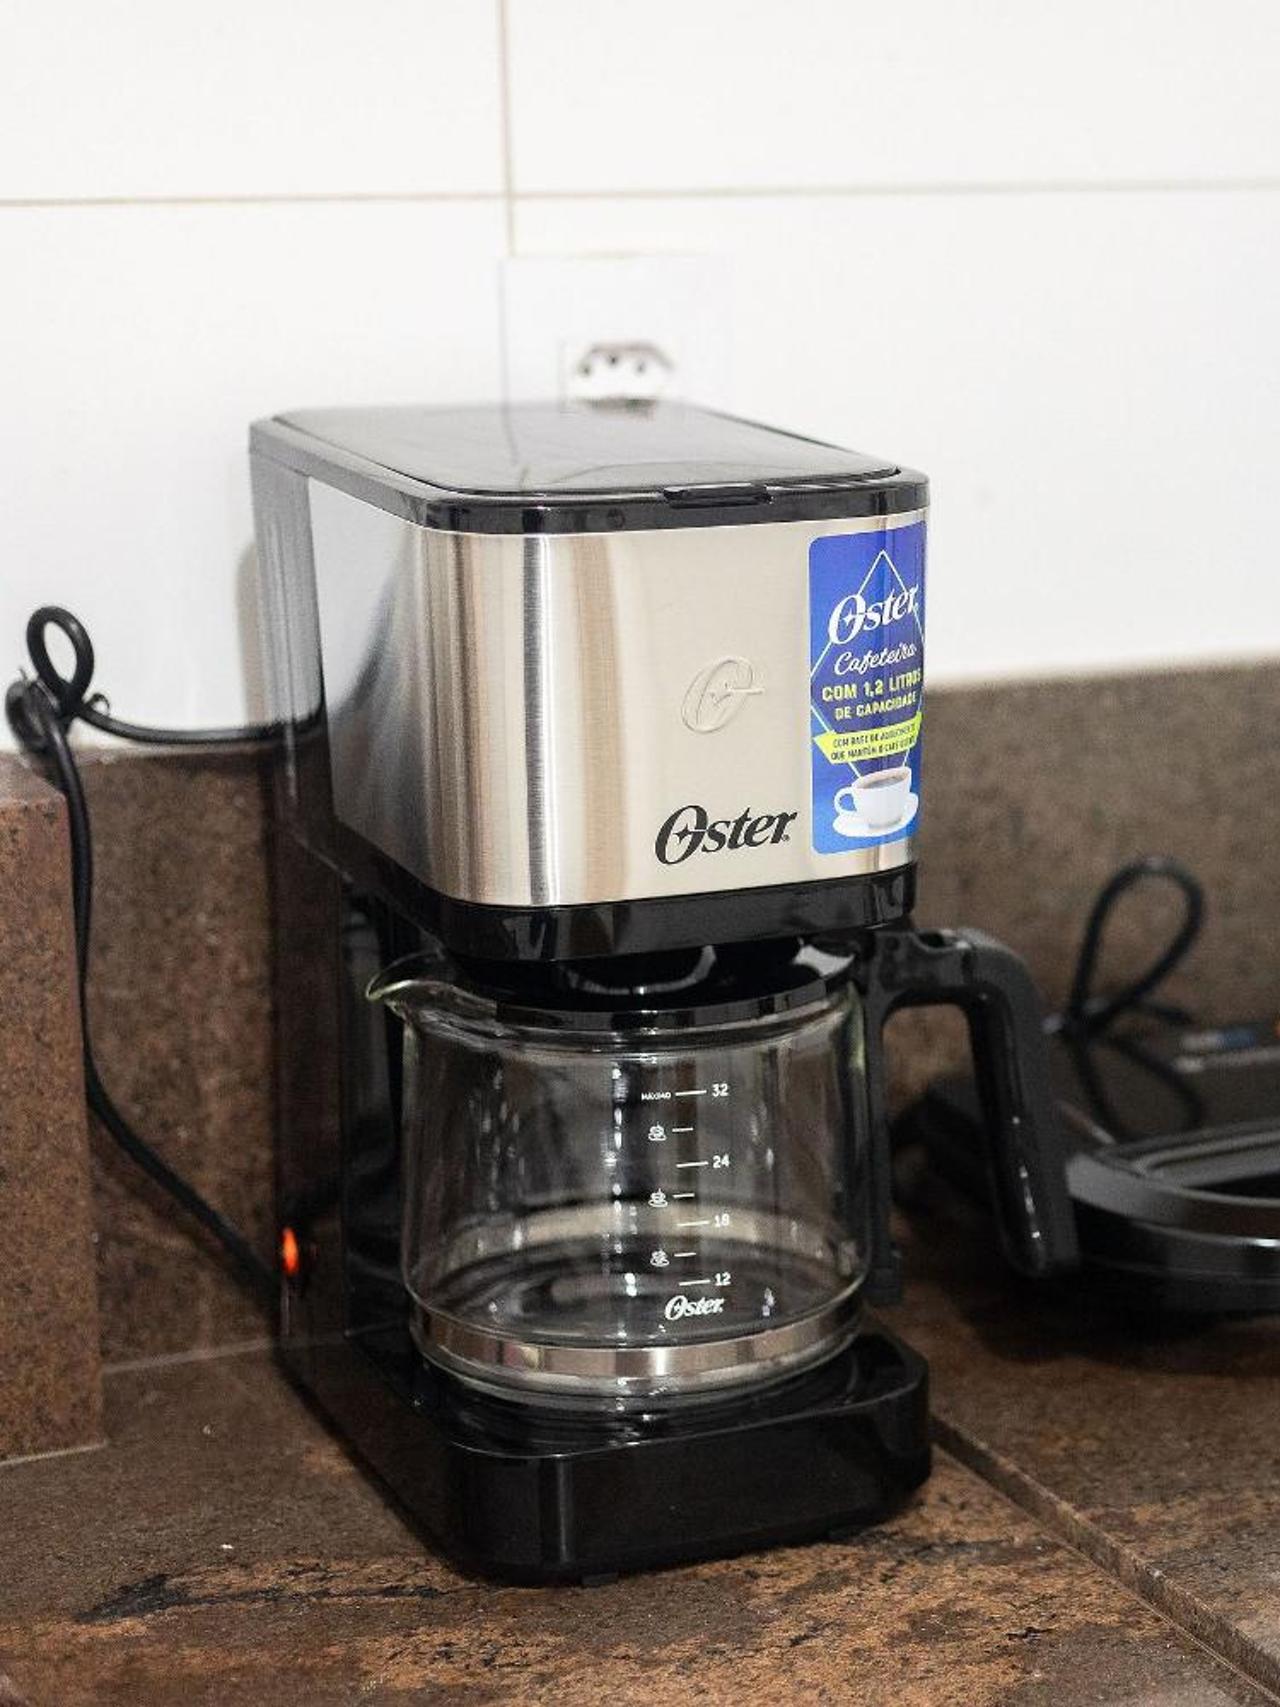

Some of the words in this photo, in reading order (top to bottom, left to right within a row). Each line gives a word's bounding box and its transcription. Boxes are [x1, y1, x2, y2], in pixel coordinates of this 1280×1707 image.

[828, 584, 919, 644] Oster
[834, 642, 917, 675] Cafeteira
[822, 683, 857, 702] COM
[889, 668, 921, 692] LITROS
[835, 706, 852, 720] DE
[856, 691, 917, 717] CAPACIDADE
[655, 804, 797, 865] Oster
[711, 1083, 729, 1097] 32
[712, 1154, 730, 1169] 24
[714, 1213, 730, 1228] 18
[715, 1272, 731, 1286] 12
[664, 1295, 725, 1321] Oster
